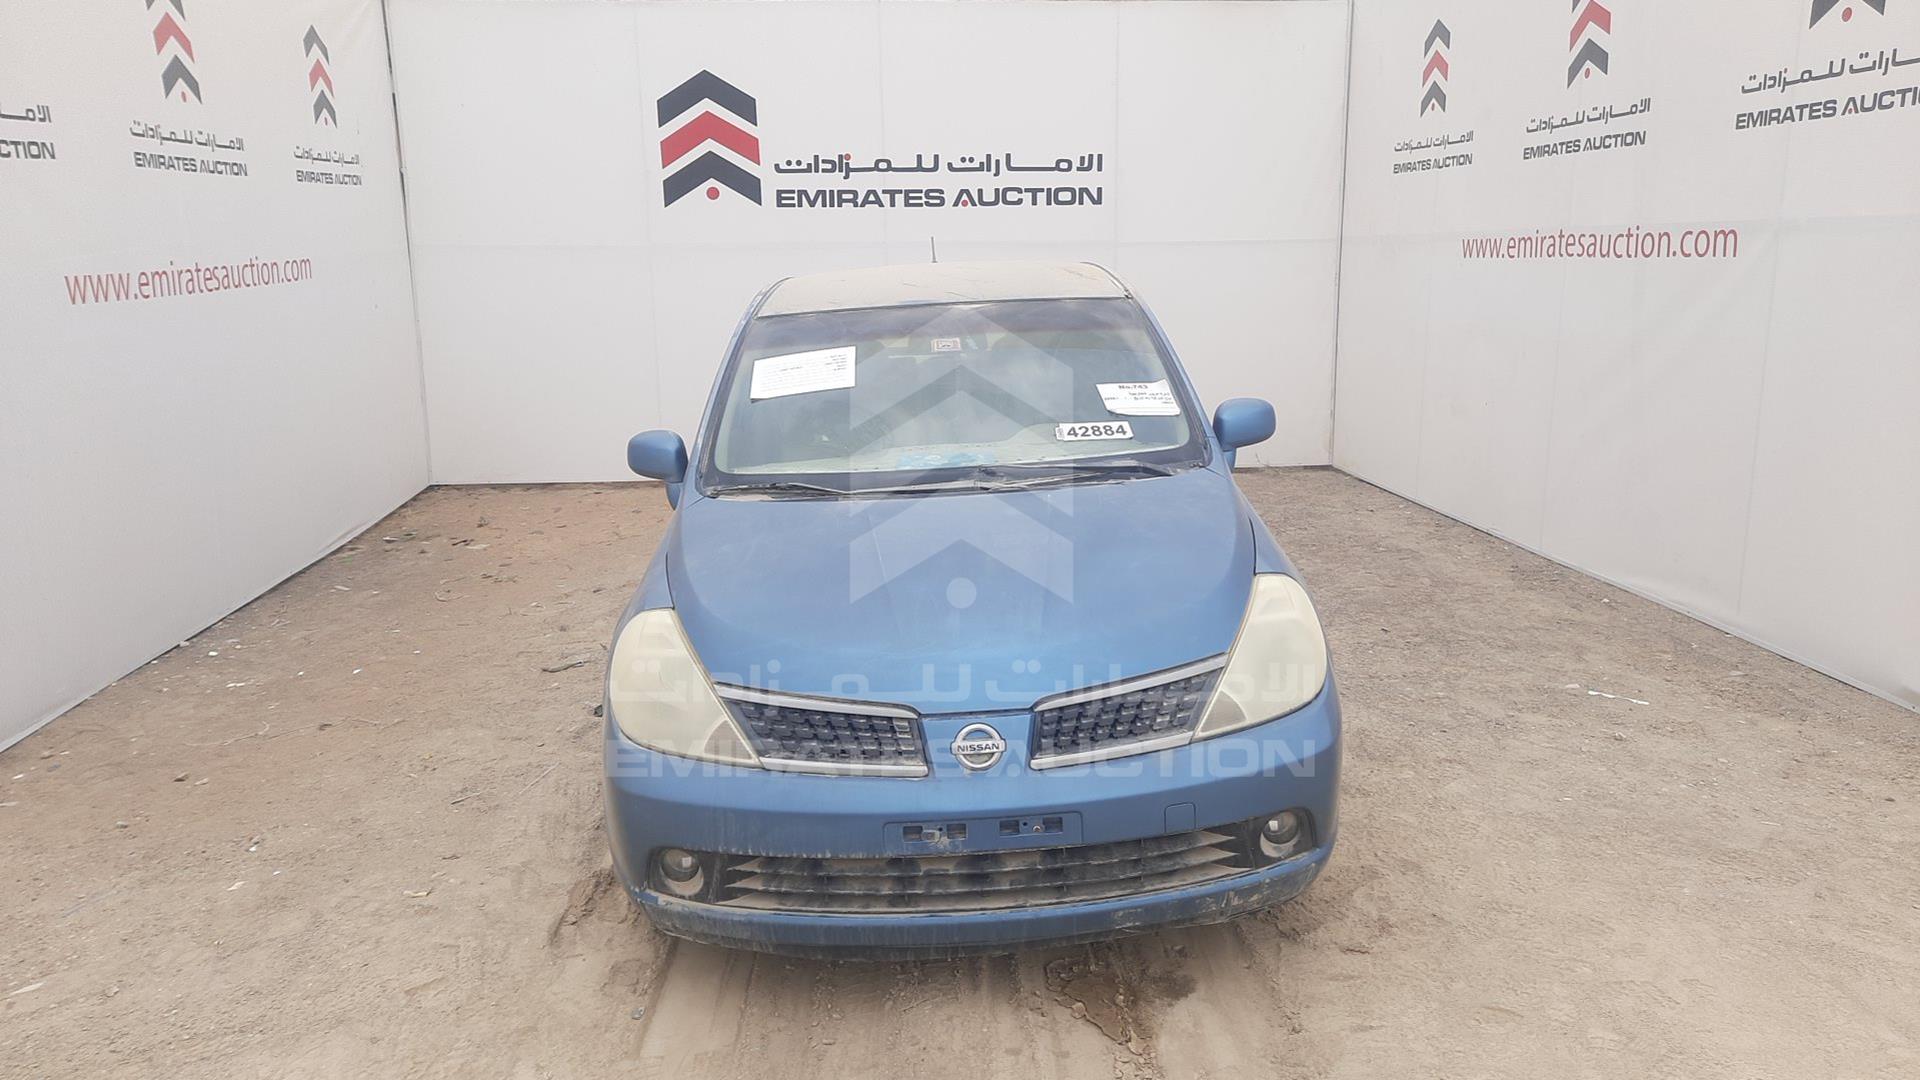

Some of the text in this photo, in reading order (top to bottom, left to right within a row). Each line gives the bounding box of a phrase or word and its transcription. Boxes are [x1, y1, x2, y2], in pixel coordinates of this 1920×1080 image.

[1735, 86, 1920, 130] EMIRATES AUCTI
[1523, 130, 1647, 160] EMIRATES AUCTION
[133, 151, 248, 176] EMIRATES AUCTION
[774, 153, 940, 180] للمزادات
[1393, 153, 1473, 174] EMIRATES AUCTION
[296, 170, 362, 186] EMIRATES AUCTION
[776, 186, 1102, 208] EMIRATES AUCTION
[1461, 226, 1738, 259] www.emiratesauction.com
[64, 257, 313, 305] www.emiratesauction.com
[1066, 424, 1128, 438] 42884
[957, 743, 1000, 753] NISSAN
